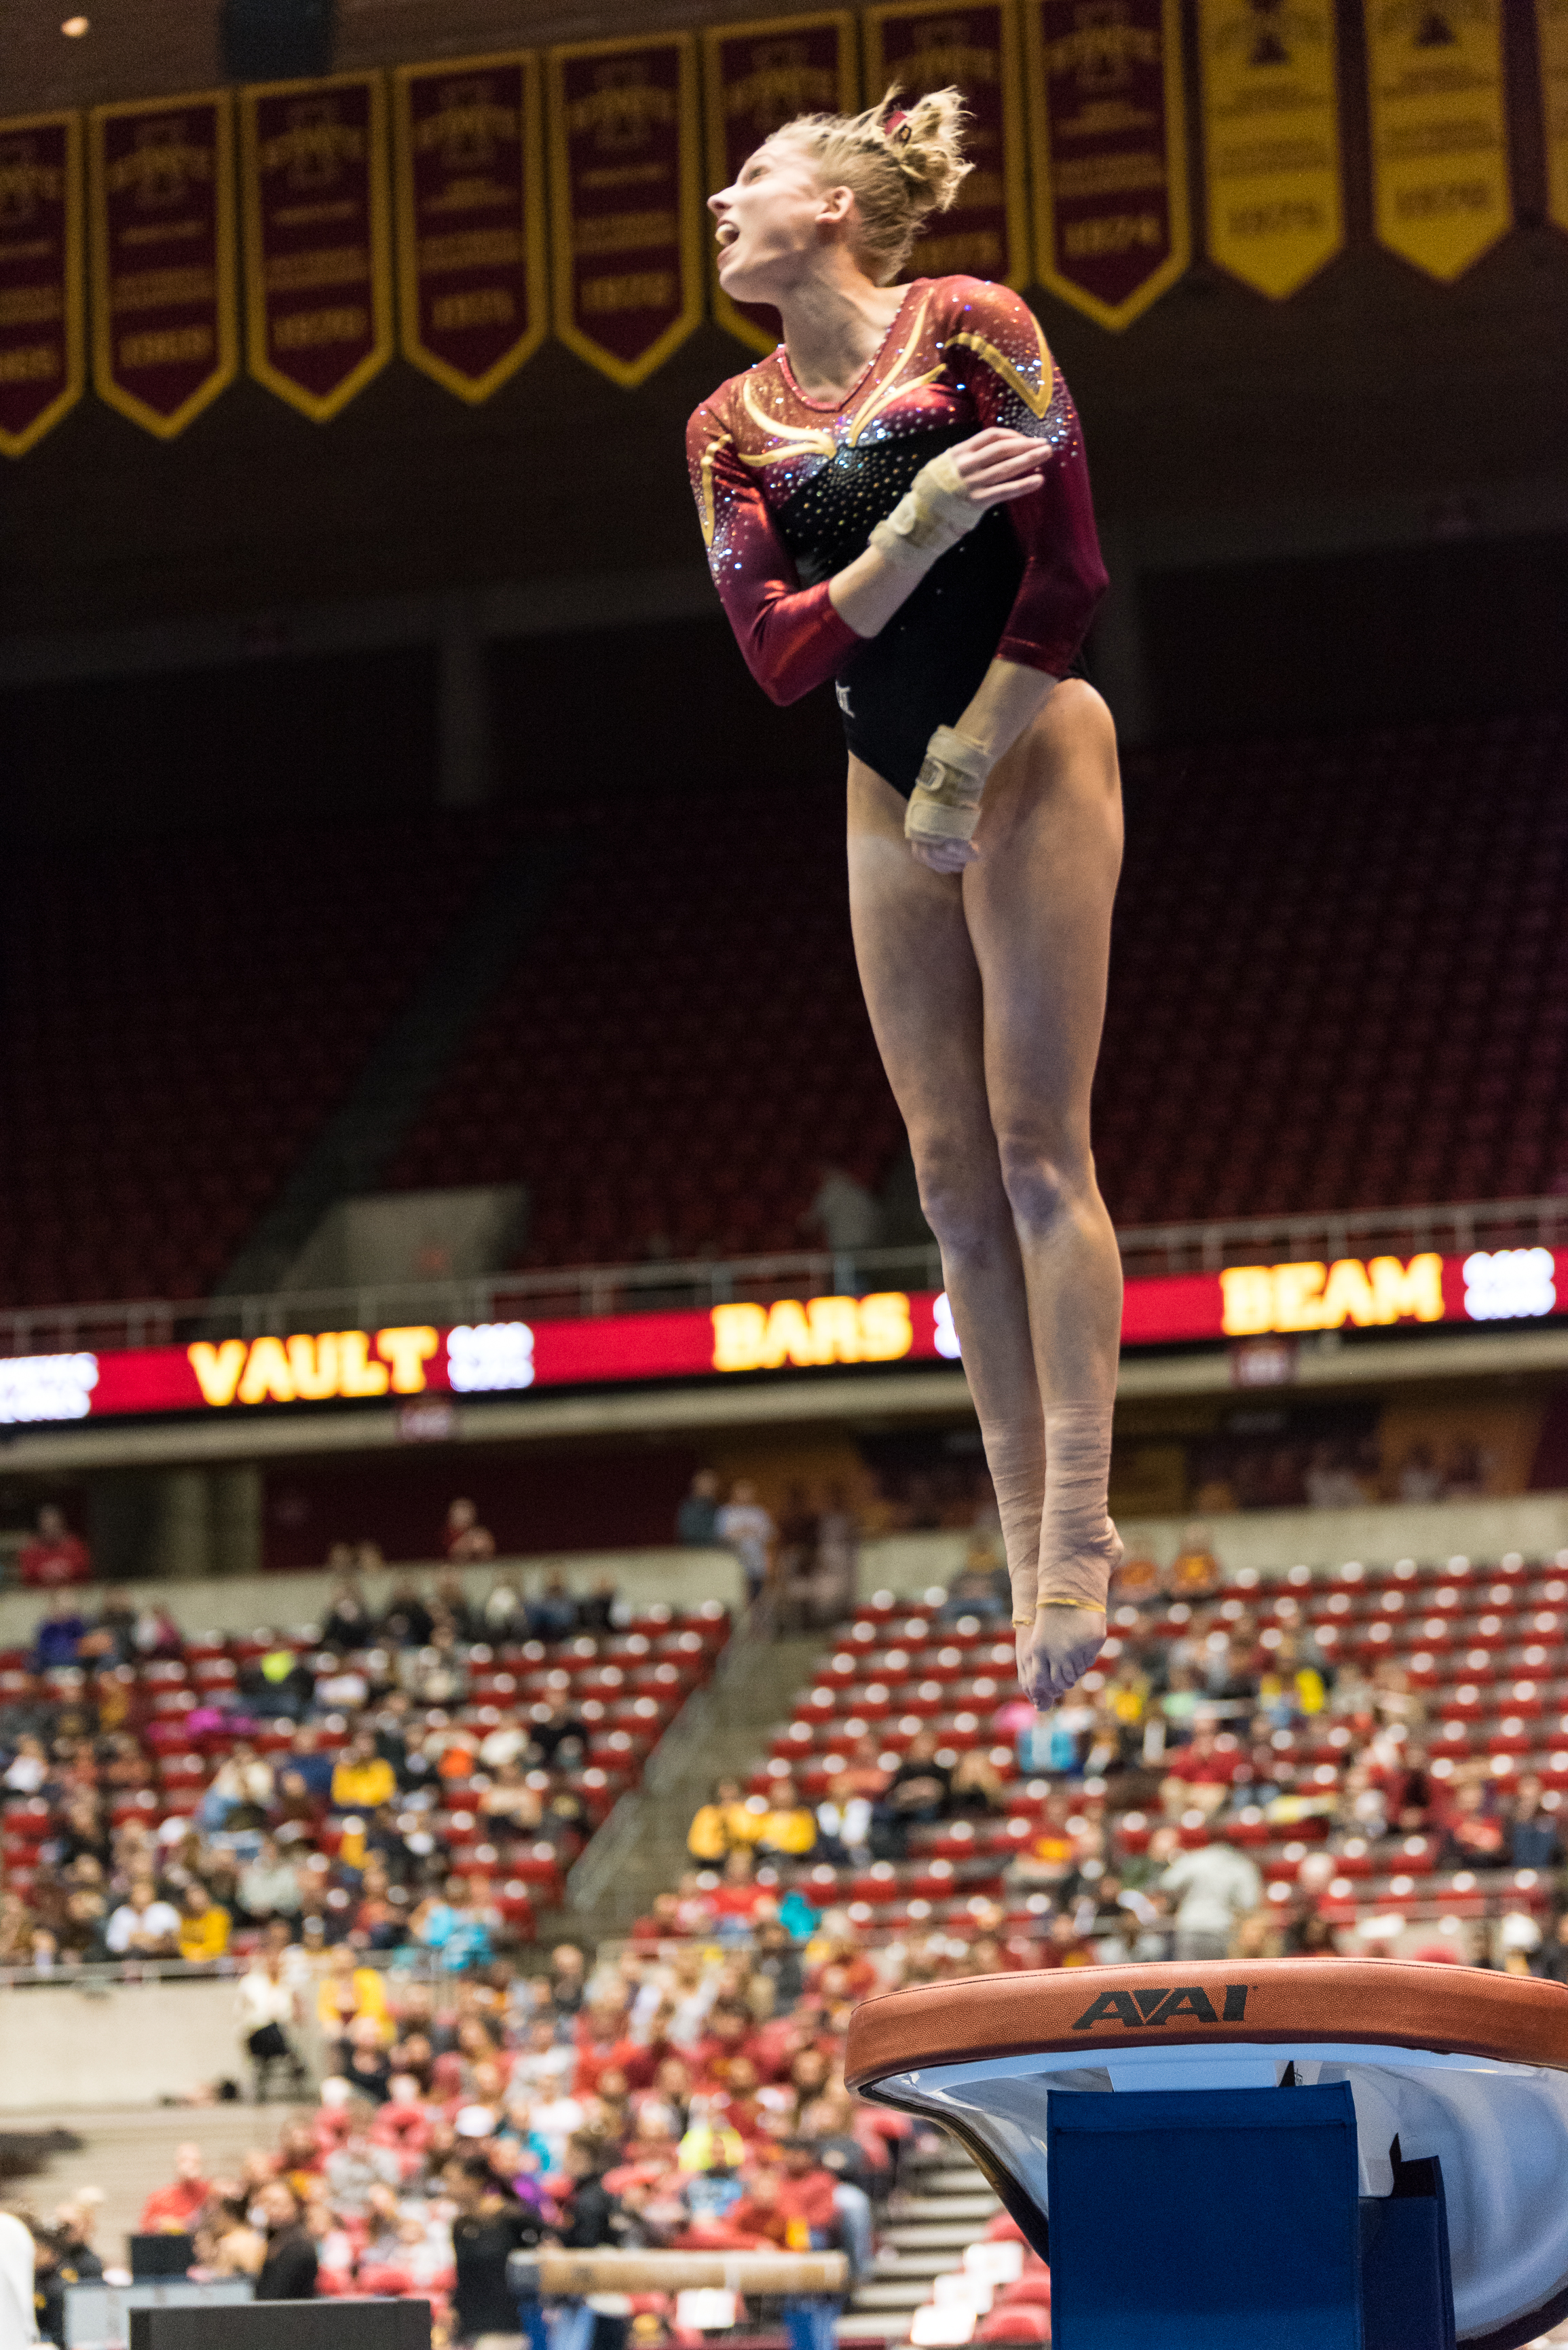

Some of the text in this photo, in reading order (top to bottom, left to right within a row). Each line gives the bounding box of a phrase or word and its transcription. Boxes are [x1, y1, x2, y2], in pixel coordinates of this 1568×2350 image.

[711, 1291, 913, 1372] BARS
[1220, 1253, 1444, 1336] BEAM
[187, 1325, 439, 1406] VAULT
